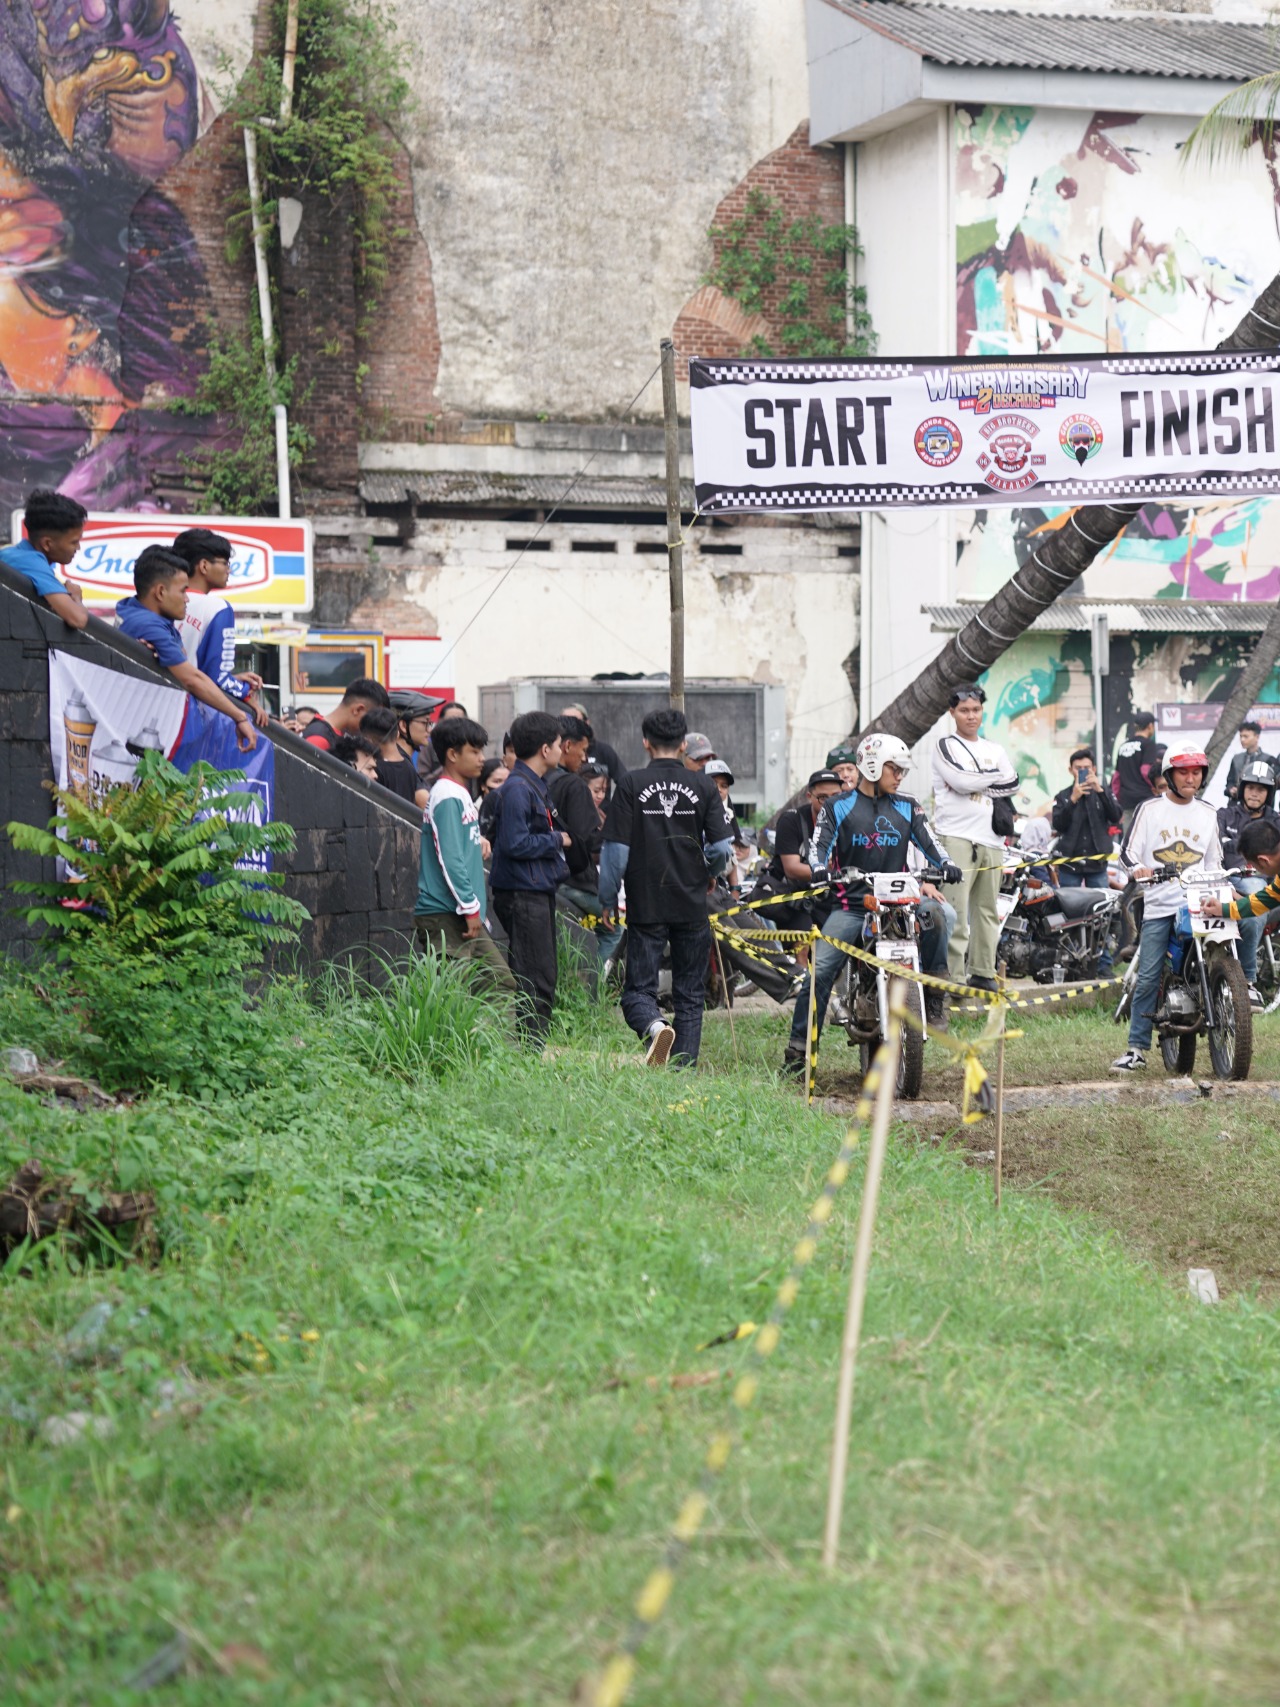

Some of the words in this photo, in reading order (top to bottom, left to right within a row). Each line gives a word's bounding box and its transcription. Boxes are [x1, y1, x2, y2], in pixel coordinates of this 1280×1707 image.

[951, 365, 971, 373] HONDA
[923, 365, 1090, 402] WINERVERSARY
[974, 387, 994, 415] 2
[992, 393, 1042, 409] DECADE
[919, 418, 942, 432] HONDA
[997, 415, 1036, 434] BROTHERS
[1120, 386, 1277, 459] FINISH
[745, 396, 892, 469] START
[920, 450, 958, 466] ADVENTURE
[991, 475, 1033, 490] JAKARTA
[890, 880, 906, 893] 9
[1203, 919, 1225, 930] 14
[890, 949, 905, 960] 5
